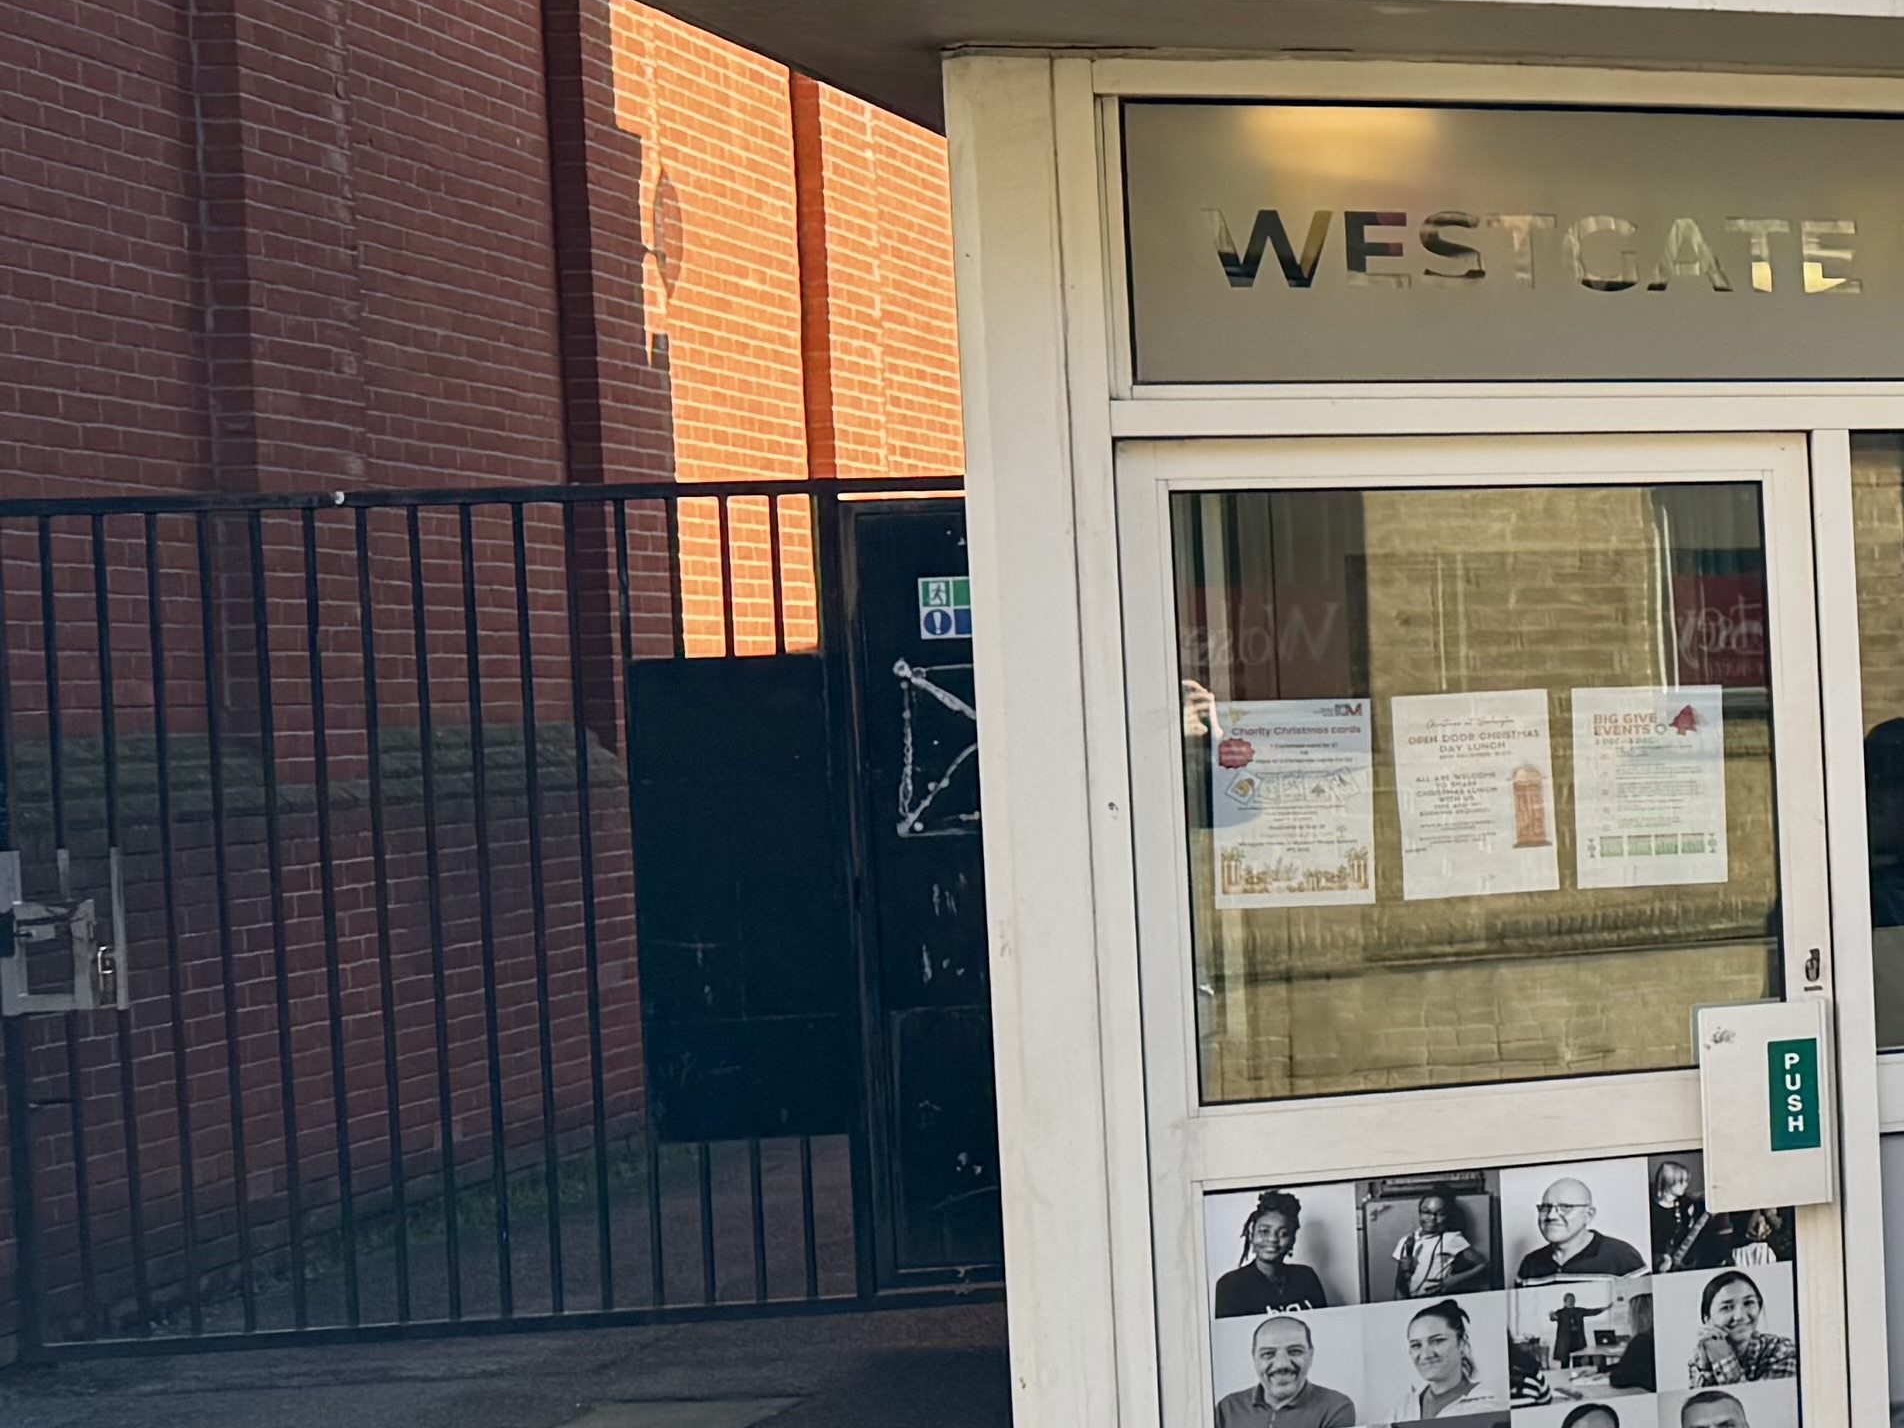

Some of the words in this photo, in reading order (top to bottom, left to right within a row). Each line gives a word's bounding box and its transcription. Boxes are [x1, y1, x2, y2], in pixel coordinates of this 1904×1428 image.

[1201, 207, 1864, 295] WESTGATE
[1594, 713, 1619, 725] BIG
[1622, 712, 1658, 724] GIVE
[1231, 727, 1272, 738] Charity
[1273, 726, 1330, 736] Christmas
[1331, 725, 1362, 735] cards
[1593, 723, 1651, 737] EVENTS
[1408, 735, 1439, 746] OPEN
[1478, 729, 1540, 741] CHRISTMAS
[1439, 743, 1464, 754] DAY
[1467, 742, 1507, 752] LUNCH
[1452, 772, 1497, 780] WELCOME
[1784, 1052, 1805, 1133] PUSH
